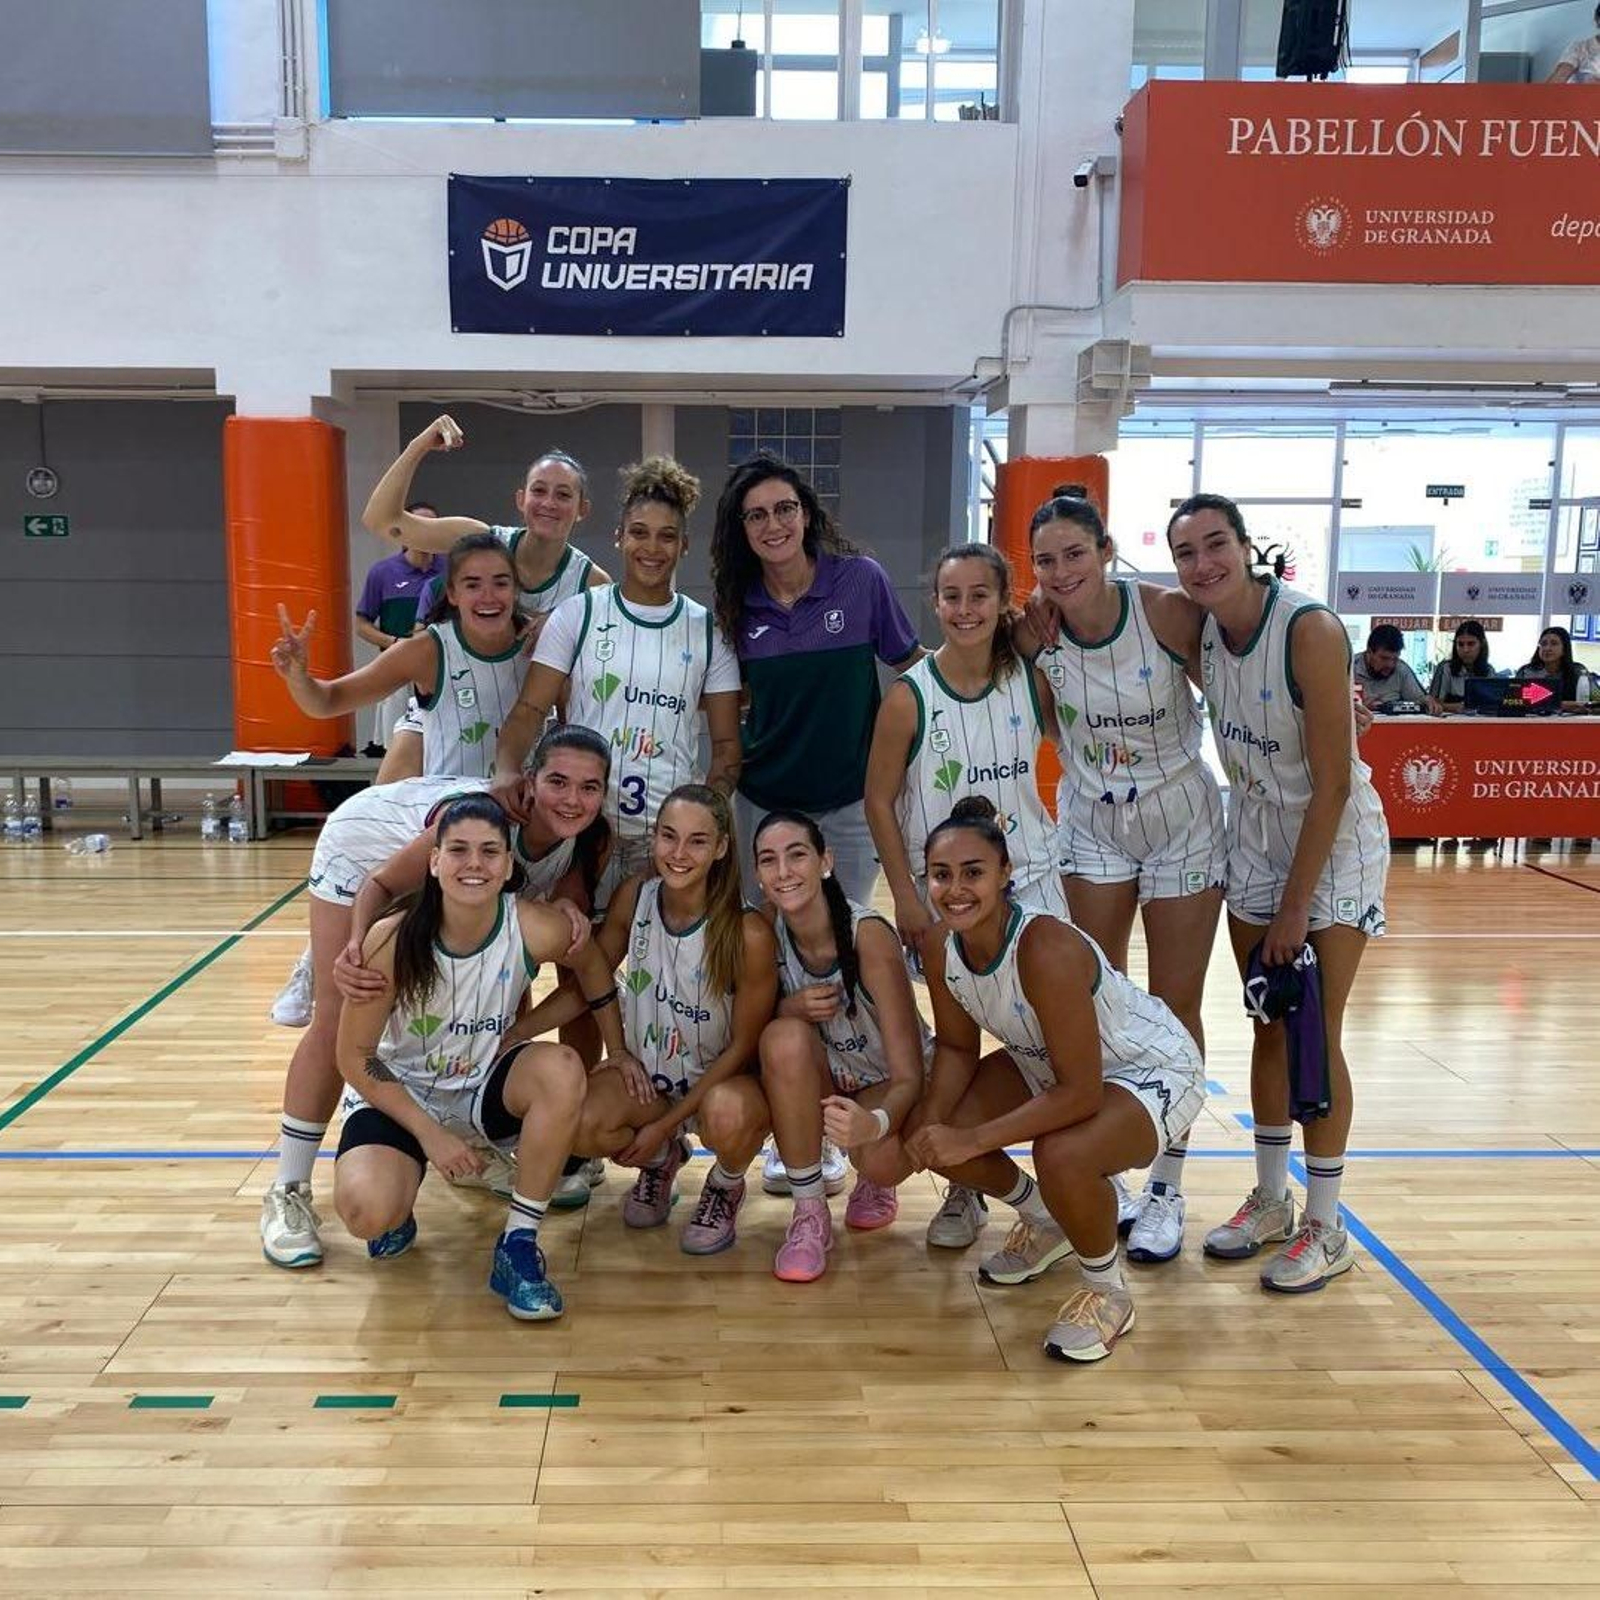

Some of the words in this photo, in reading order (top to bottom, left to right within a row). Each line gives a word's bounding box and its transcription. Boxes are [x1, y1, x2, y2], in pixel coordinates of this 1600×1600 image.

[1226, 110, 1467, 157] PABELLÓN
[1365, 210, 1495, 225] UNIVERSIDAD
[547, 226, 637, 255] COPA
[1364, 229, 1388, 244] DE
[1390, 228, 1493, 244] GRANADA
[541, 263, 814, 291] UNIVERSITARIA
[1085, 708, 1166, 729] Unicaja
[1475, 760, 1600, 775] UNIVERSID
[619, 775, 646, 816] 3
[1473, 783, 1501, 798] DE
